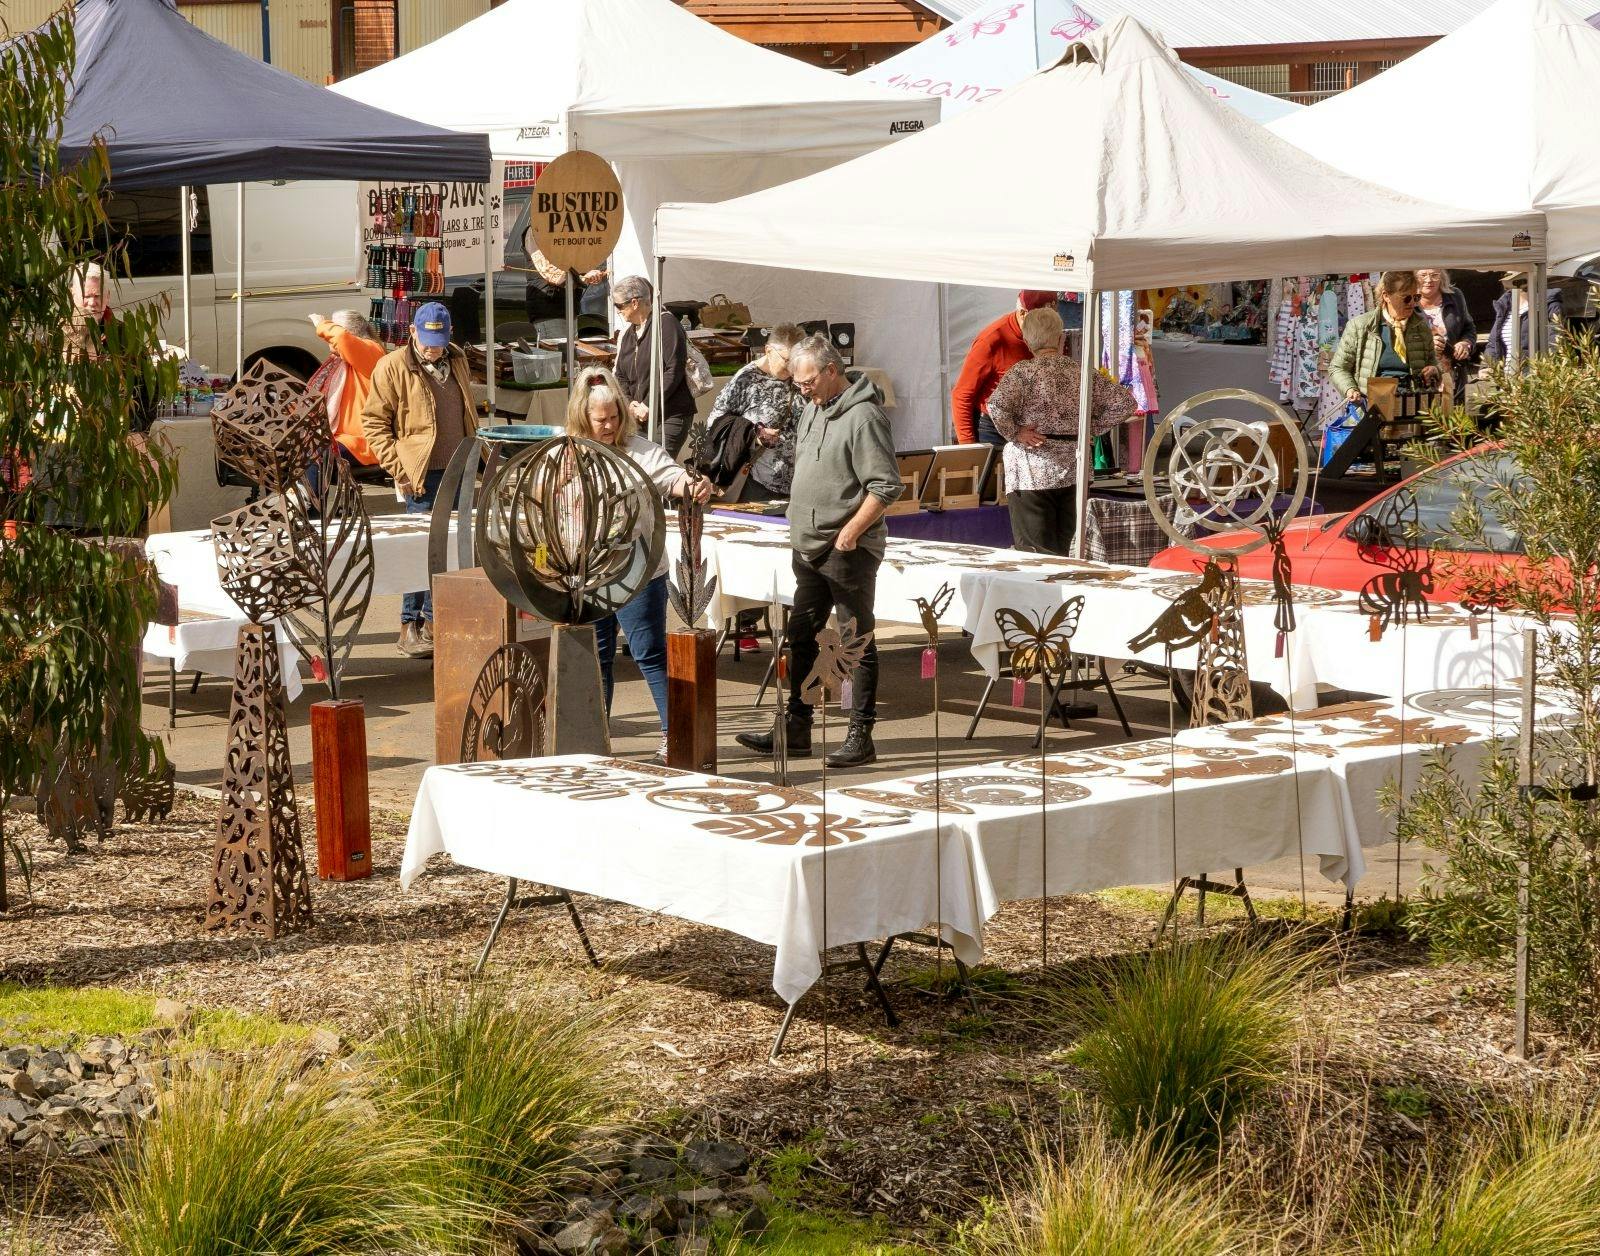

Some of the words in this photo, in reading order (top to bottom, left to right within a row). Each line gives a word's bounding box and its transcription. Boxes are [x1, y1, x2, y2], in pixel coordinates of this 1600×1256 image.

[516, 126, 550, 141] ALTEGRA
[889, 120, 925, 135] ALTEGRA
[536, 191, 619, 213] BUSTED
[548, 211, 608, 233] PAWS
[553, 238, 566, 246] PET
